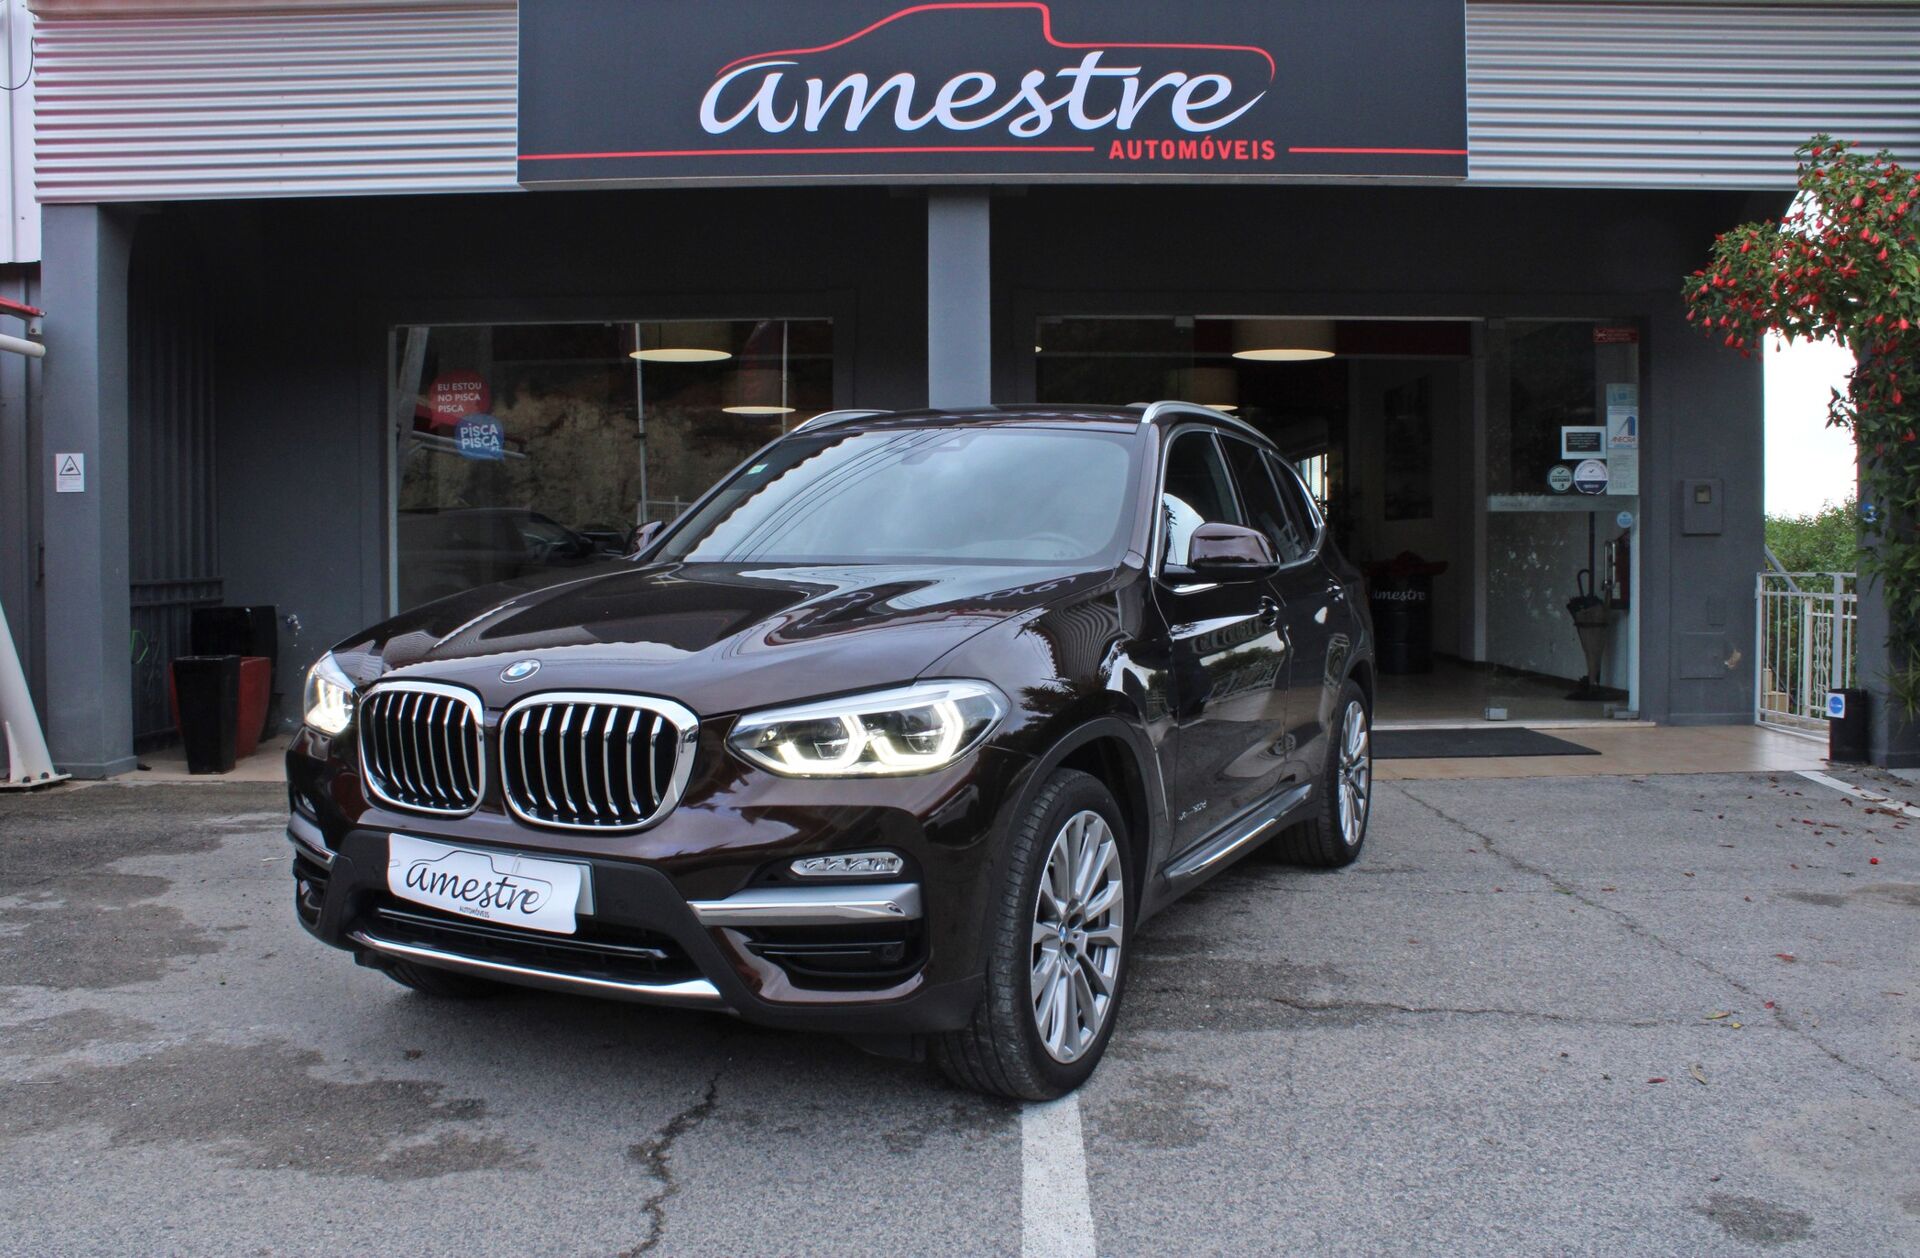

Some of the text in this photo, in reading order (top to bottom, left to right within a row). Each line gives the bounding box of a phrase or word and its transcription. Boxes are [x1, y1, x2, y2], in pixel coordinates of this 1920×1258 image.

[699, 51, 1266, 138] amestre
[1108, 136, 1276, 161] AUTOMÓVEIS
[437, 382, 482, 392] EU ESTOU
[437, 393, 481, 402] NO PISCA
[437, 404, 464, 413] PISCA
[406, 862, 544, 914] amestre
